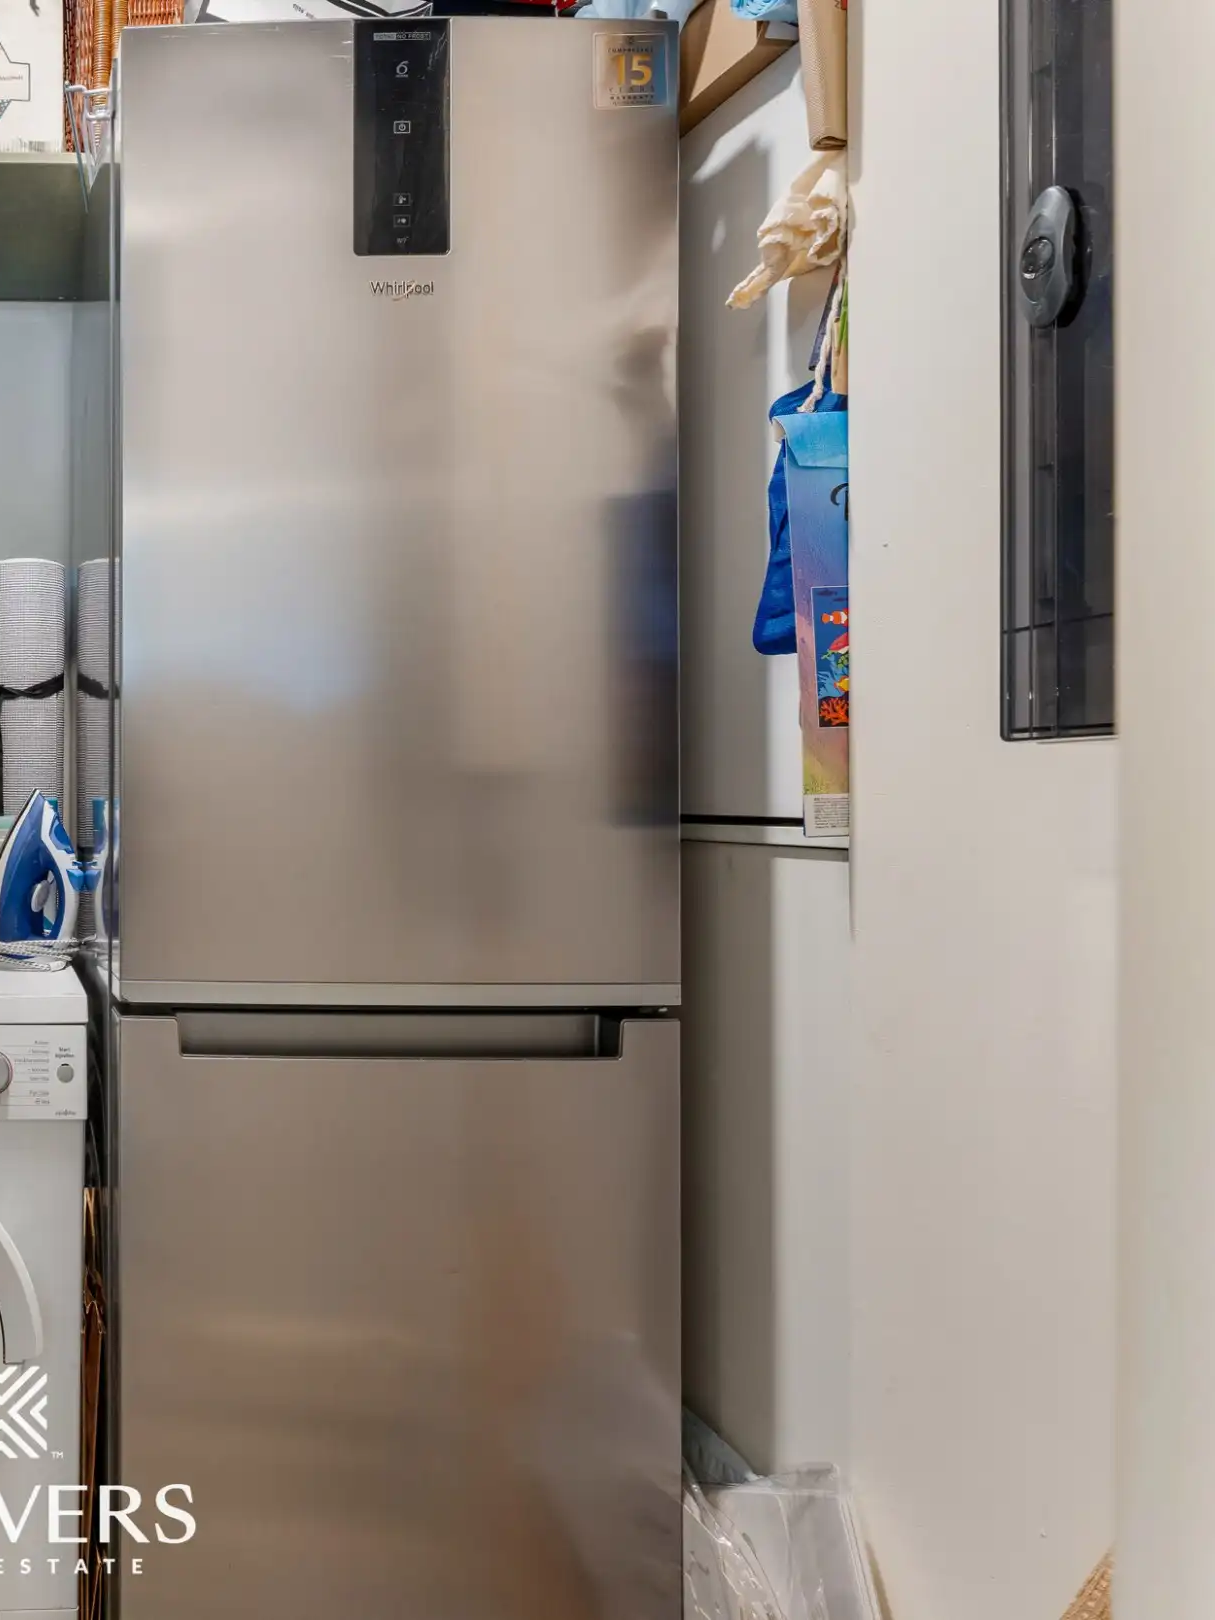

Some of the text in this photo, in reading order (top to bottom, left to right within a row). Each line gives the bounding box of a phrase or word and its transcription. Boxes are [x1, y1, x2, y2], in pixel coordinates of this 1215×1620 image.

[396, 60, 408, 75] 6
[610, 54, 652, 86] 15
[370, 280, 434, 299] Whirlpool
